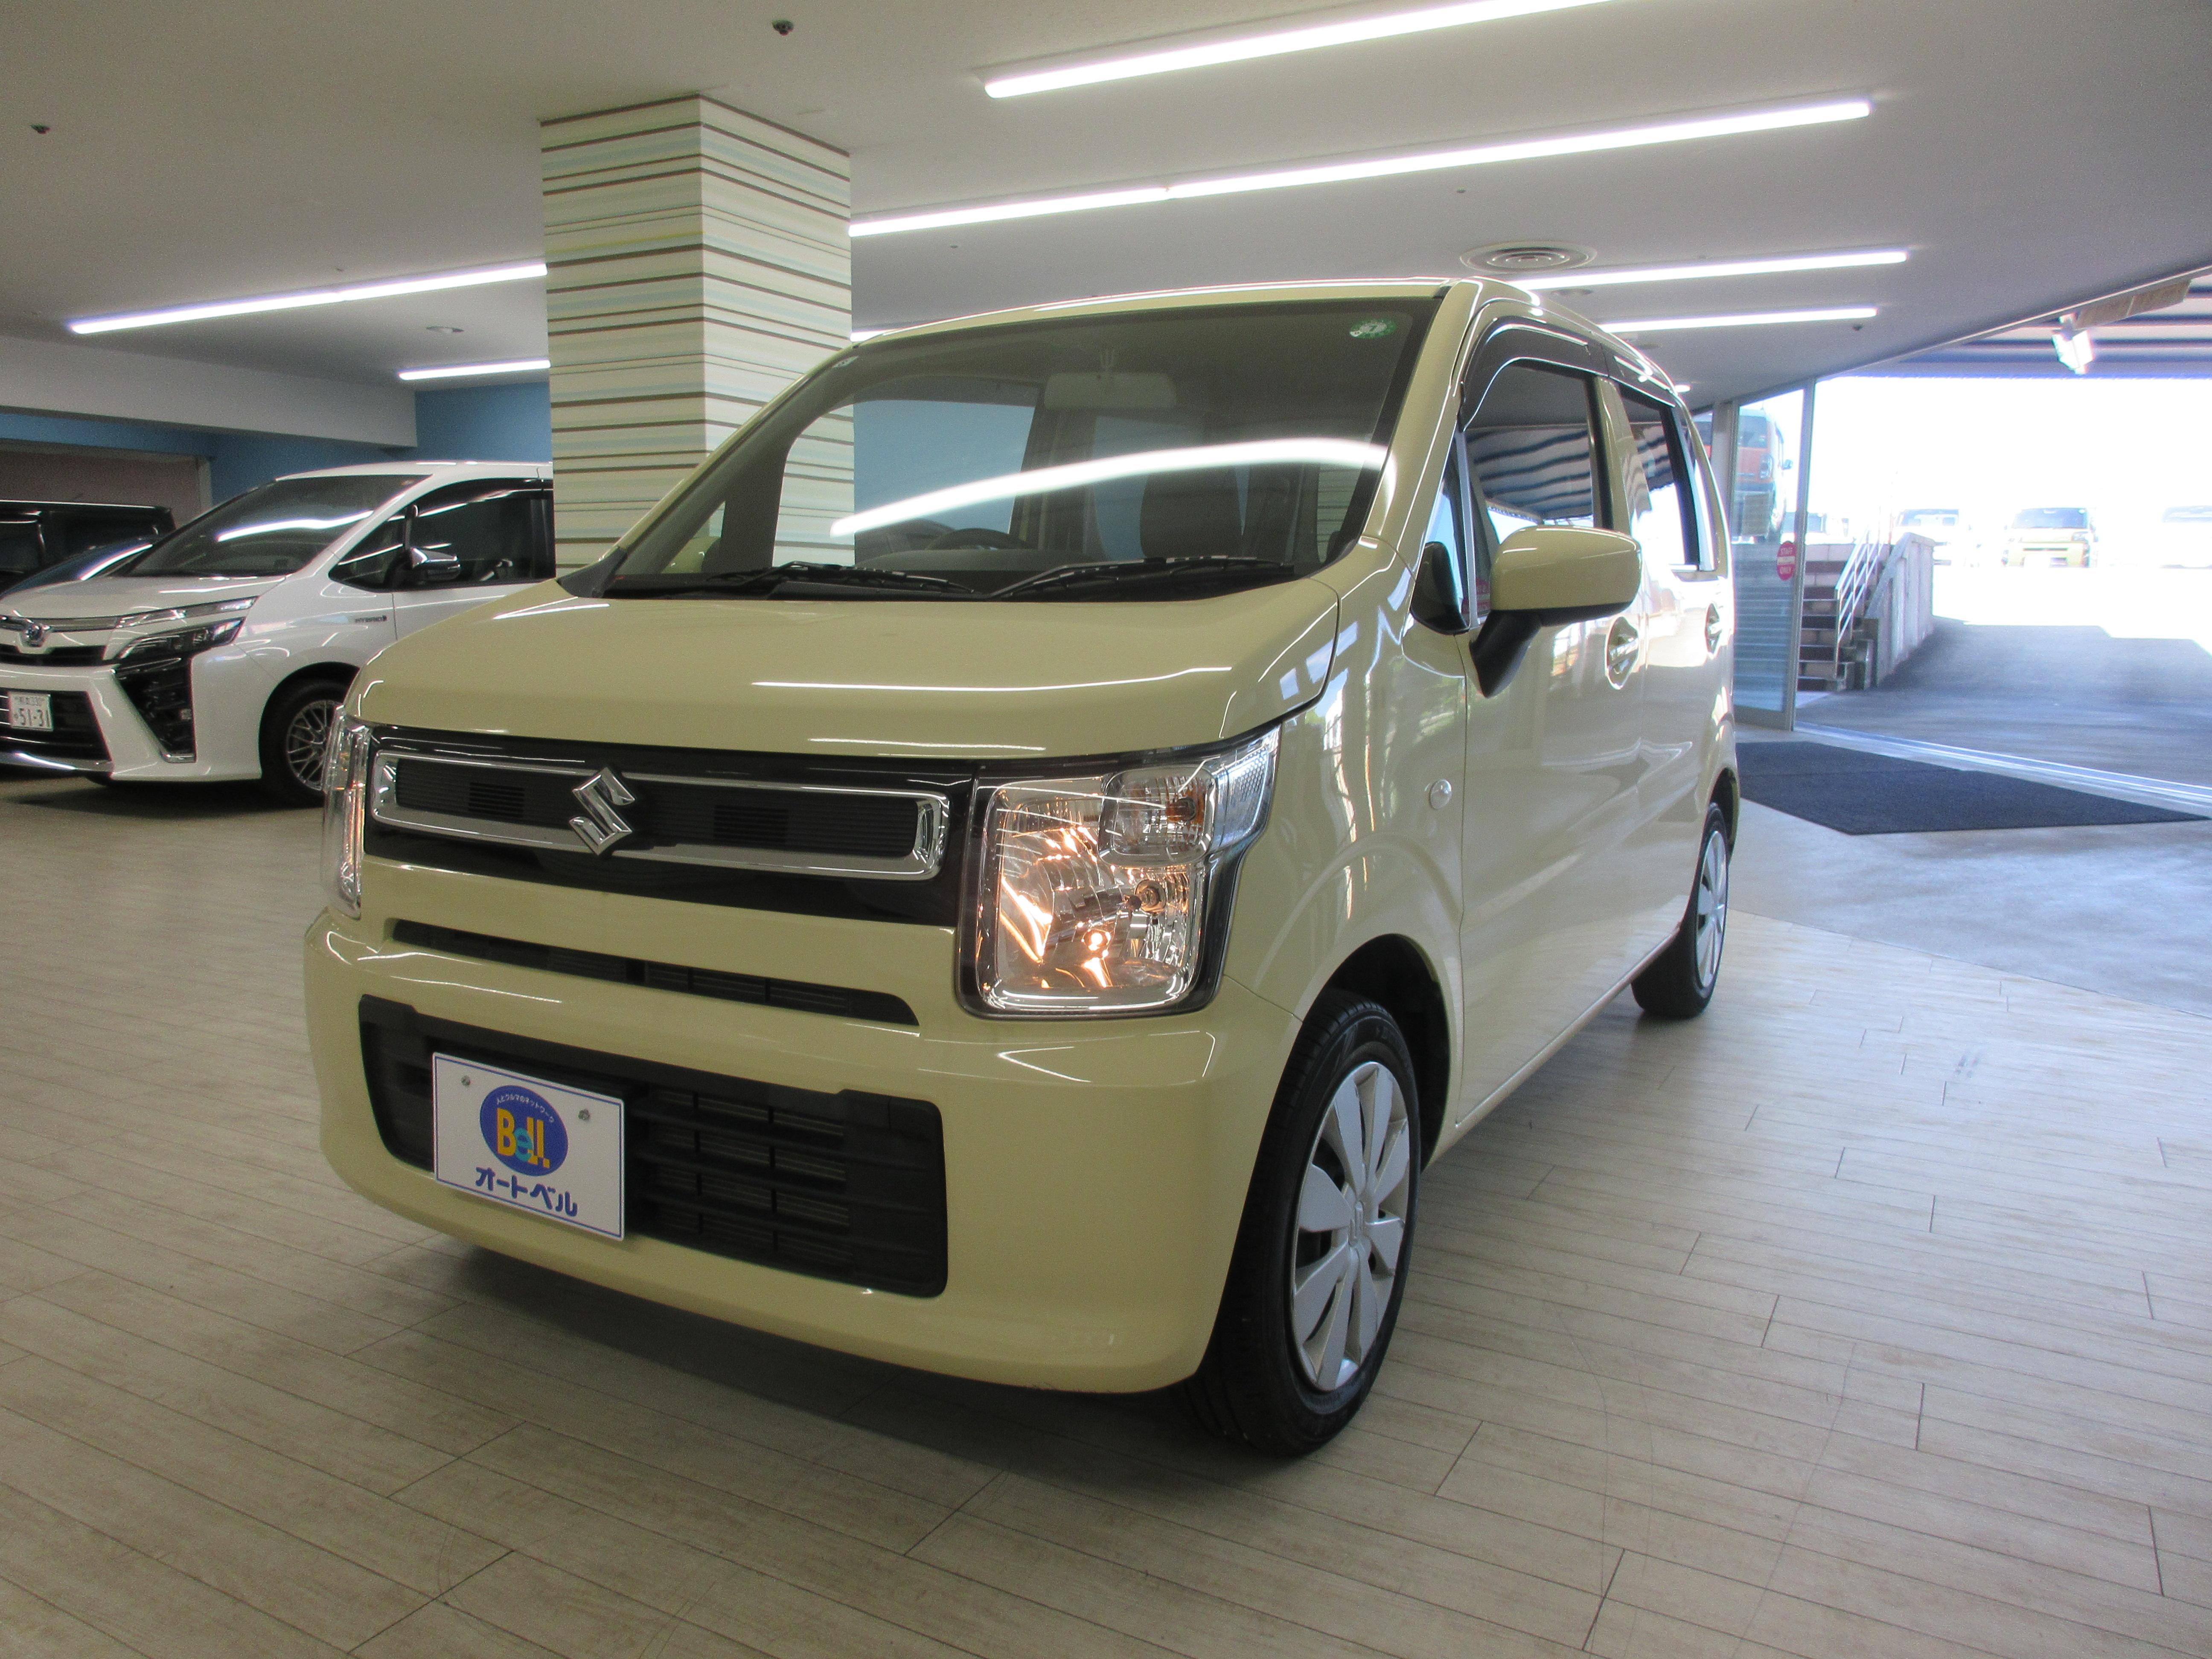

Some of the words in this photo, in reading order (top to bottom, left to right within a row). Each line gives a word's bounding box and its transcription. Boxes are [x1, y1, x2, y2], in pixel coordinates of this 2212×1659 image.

[476, 1167, 578, 1217] オートベル
